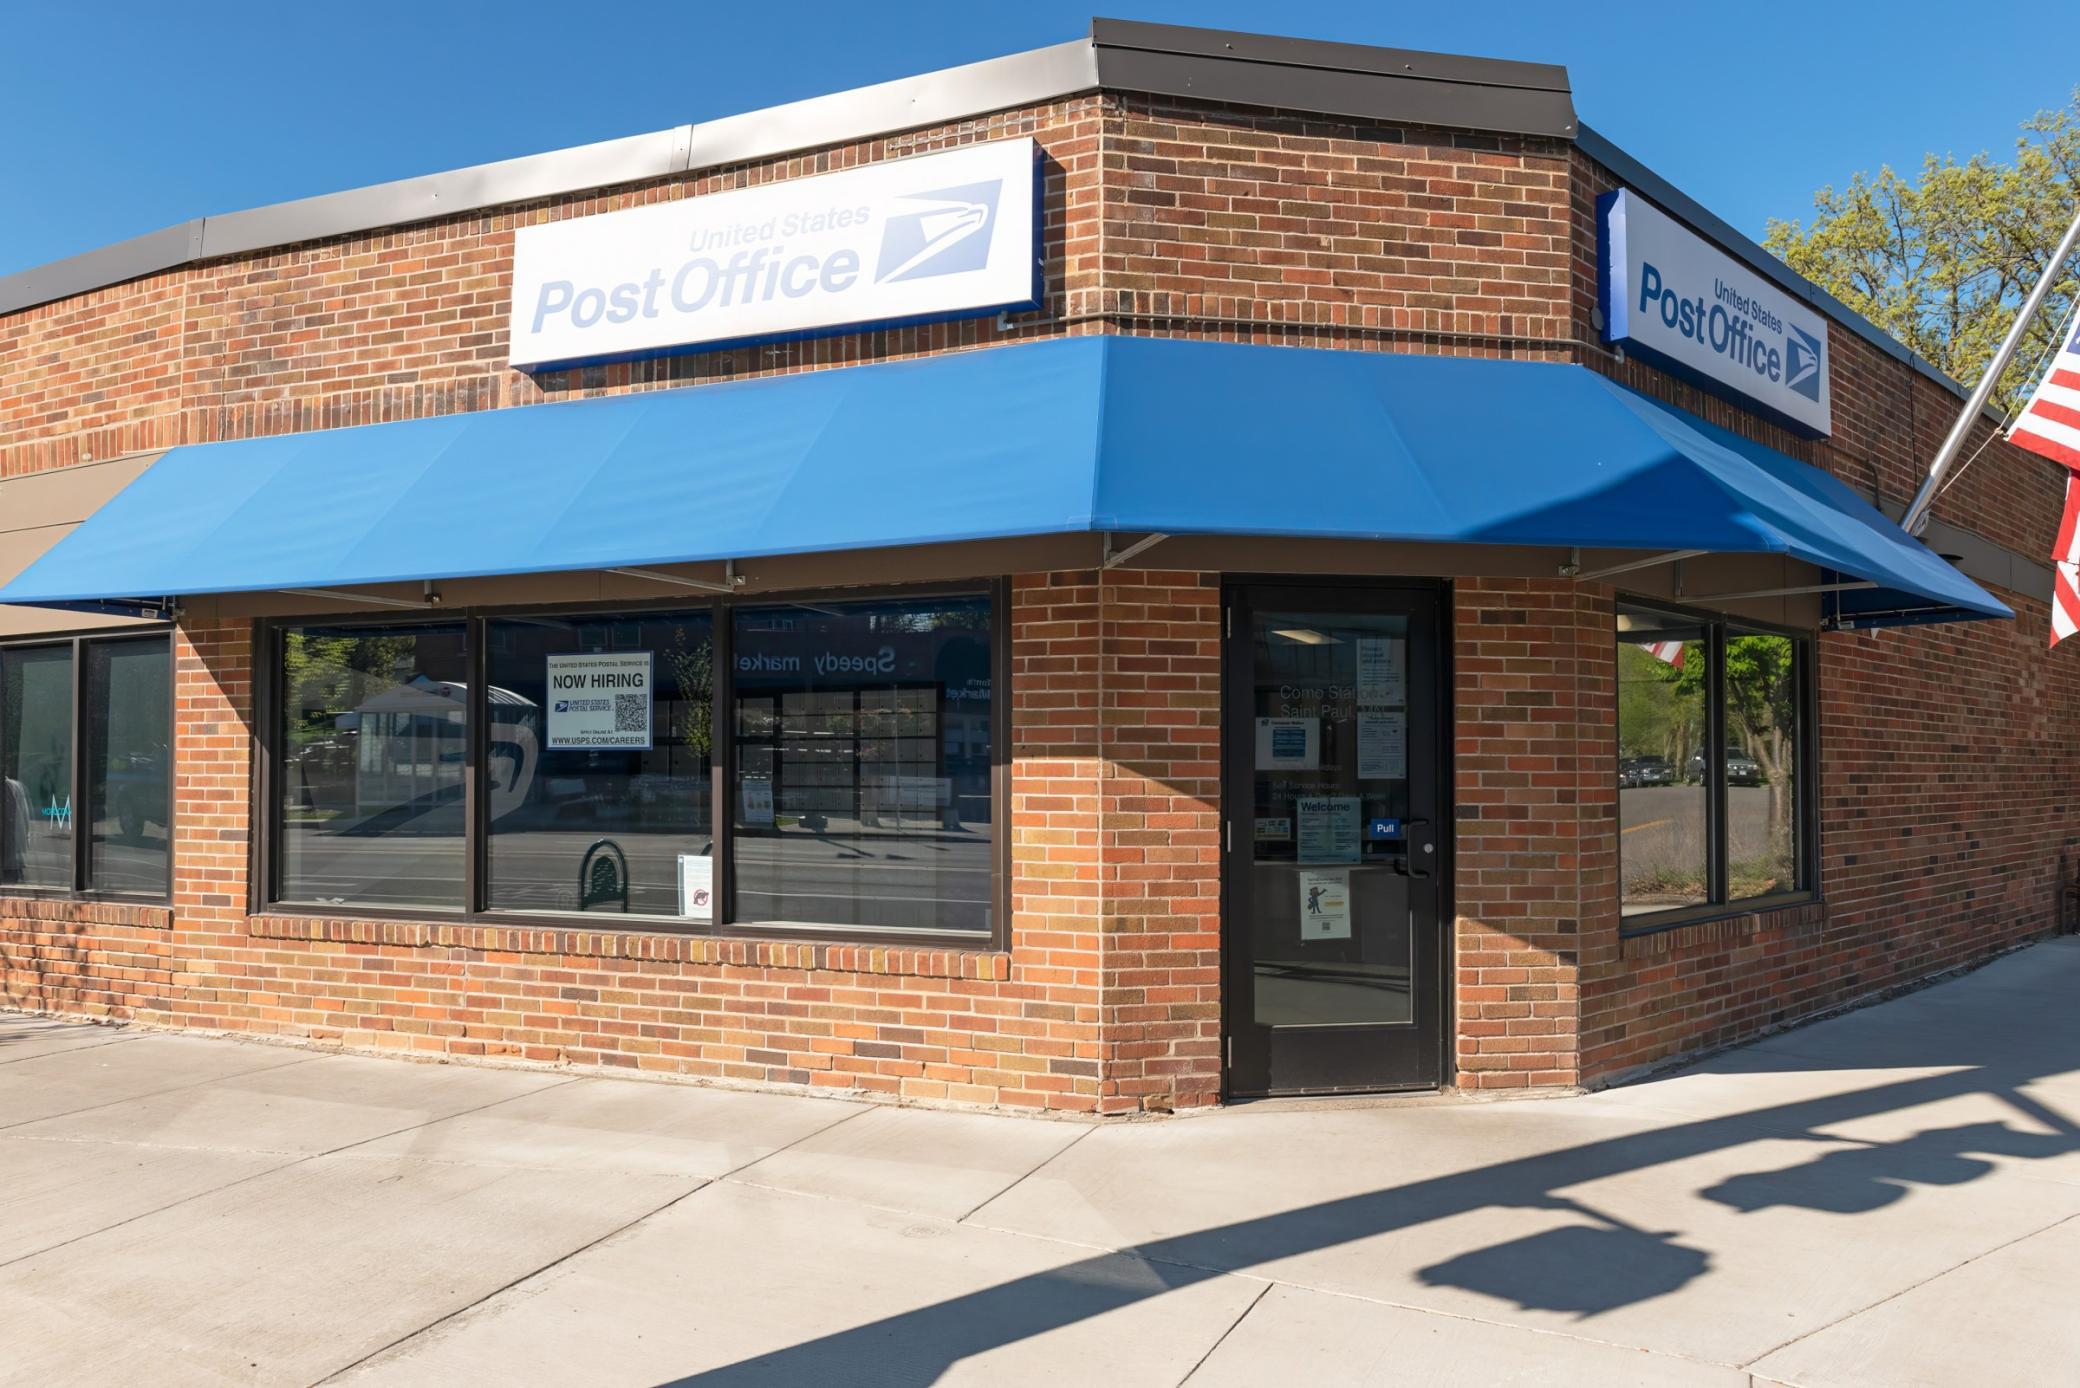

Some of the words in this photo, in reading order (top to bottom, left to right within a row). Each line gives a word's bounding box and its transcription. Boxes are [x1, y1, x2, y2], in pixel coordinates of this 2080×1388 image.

[690, 219, 774, 252] United
[781, 206, 871, 239] States
[1714, 277, 1750, 315] United
[1751, 300, 1783, 335] States
[554, 675, 585, 688] NOW
[592, 673, 643, 688] HIRING
[1280, 685, 1324, 699] Como
[1328, 685, 1379, 699] Staton
[1280, 704, 1316, 718] Saint
[553, 737, 645, 745] WWW.USPS.COM/CAREERS
[1301, 801, 1350, 812] Welcome
[1377, 823, 1395, 833] Pull
